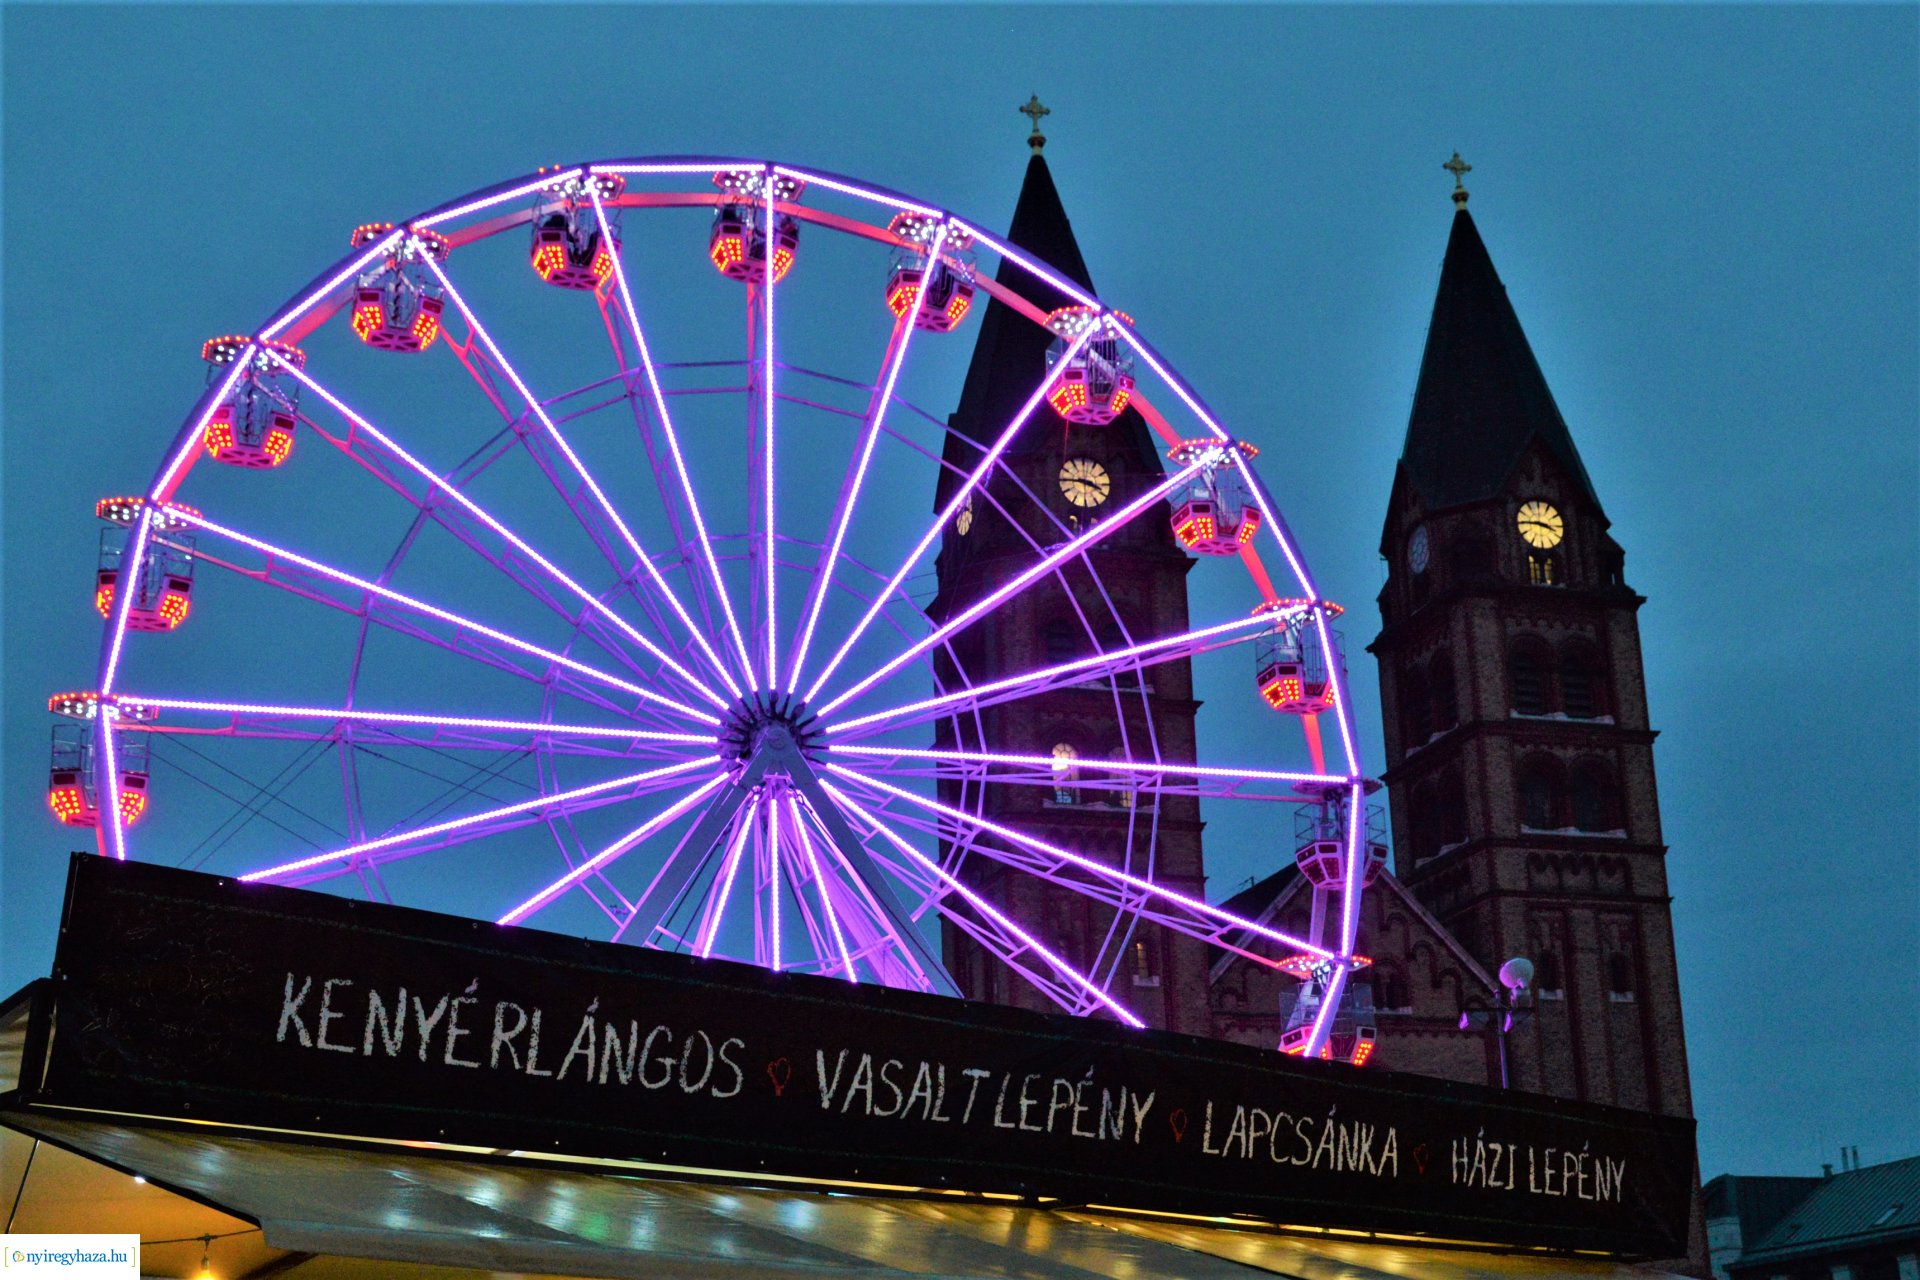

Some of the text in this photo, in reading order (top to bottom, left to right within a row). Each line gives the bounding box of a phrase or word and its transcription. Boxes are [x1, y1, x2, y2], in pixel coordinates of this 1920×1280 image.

[276, 972, 746, 1099] KENYÉRLÁNGOS
[1202, 1100, 1398, 1178] LAPCSÁNKA
[1452, 1127, 1516, 1190] HÁZI
[1529, 1140, 1627, 1202] LEPÉNY
